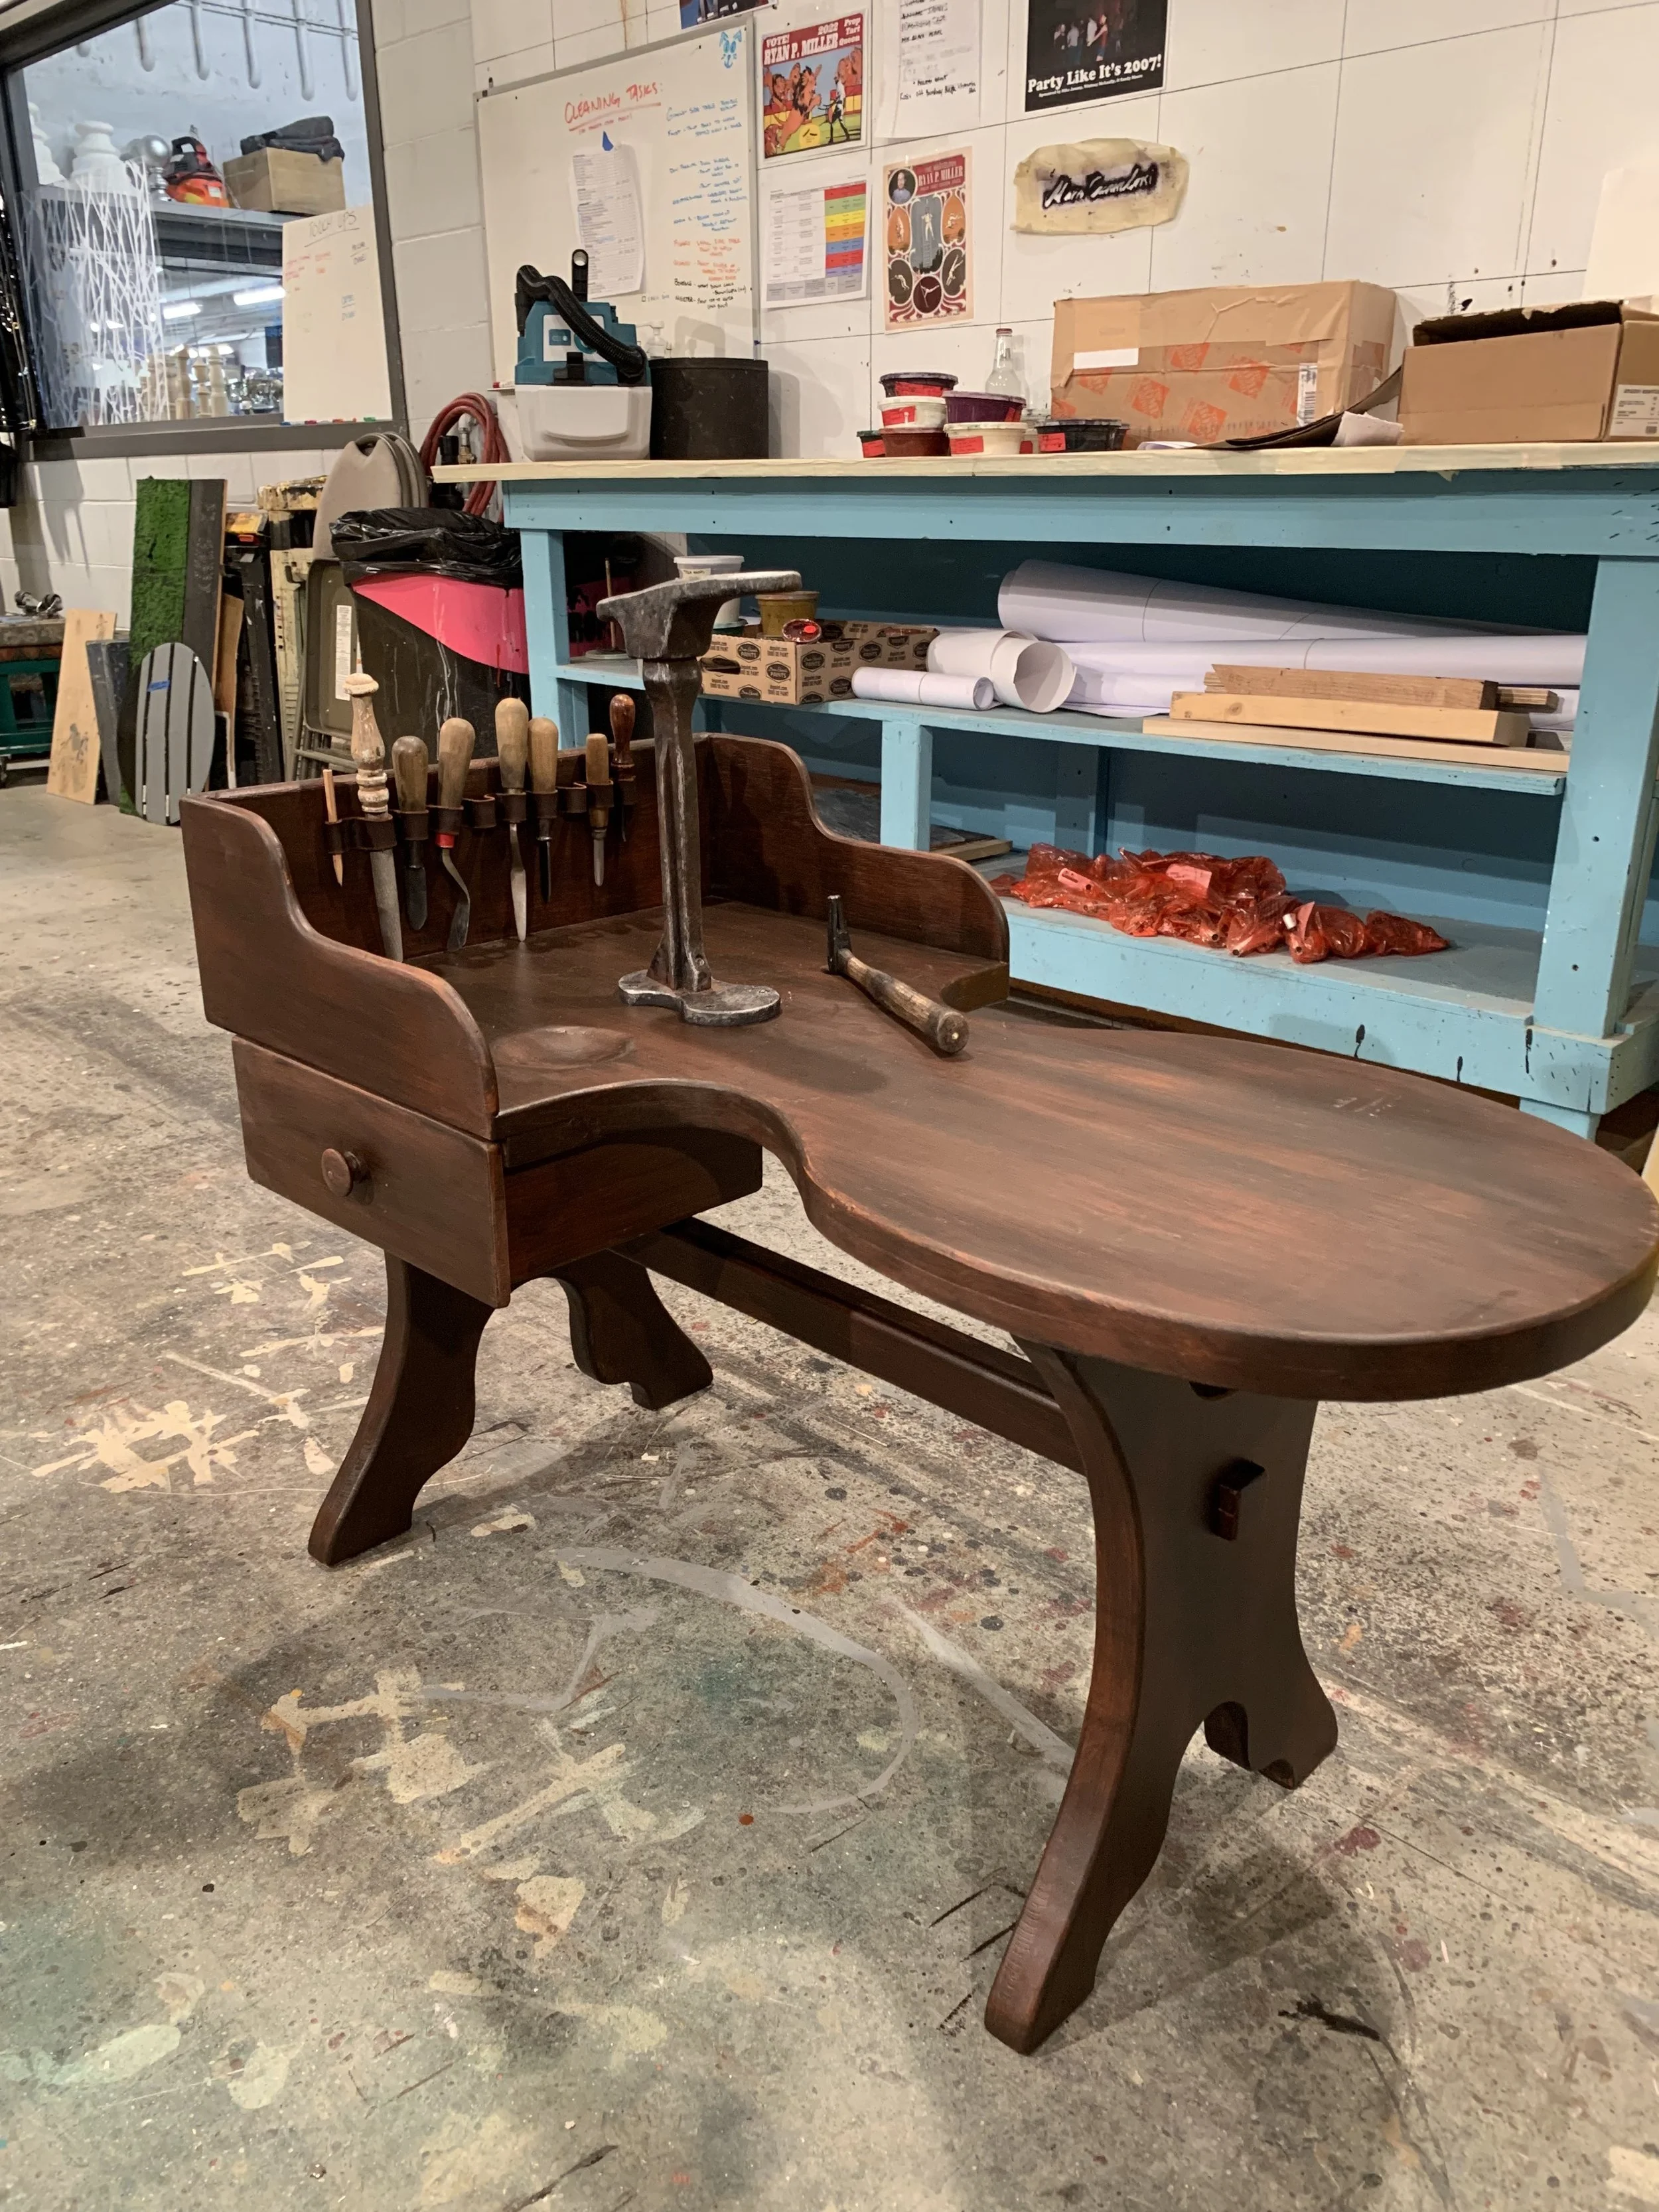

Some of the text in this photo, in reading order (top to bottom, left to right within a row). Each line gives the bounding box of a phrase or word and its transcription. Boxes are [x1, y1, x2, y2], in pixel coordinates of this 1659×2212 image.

[818, 22, 839, 35] 2022
[844, 17, 861, 27] Prop
[845, 26, 861, 35] Tart
[766, 34, 790, 48] VOTE!
[839, 36, 860, 46] Queen
[764, 33, 838, 65] RYAN P. MILLER
[1028, 76, 1064, 93] Party
[1067, 69, 1096, 85] Like
[1099, 63, 1121, 79] It's
[1123, 54, 1162, 74] 2007!
[565, 92, 620, 123] CLEANING
[918, 173, 933, 186] RYAN
[941, 165, 963, 181] MILLER
